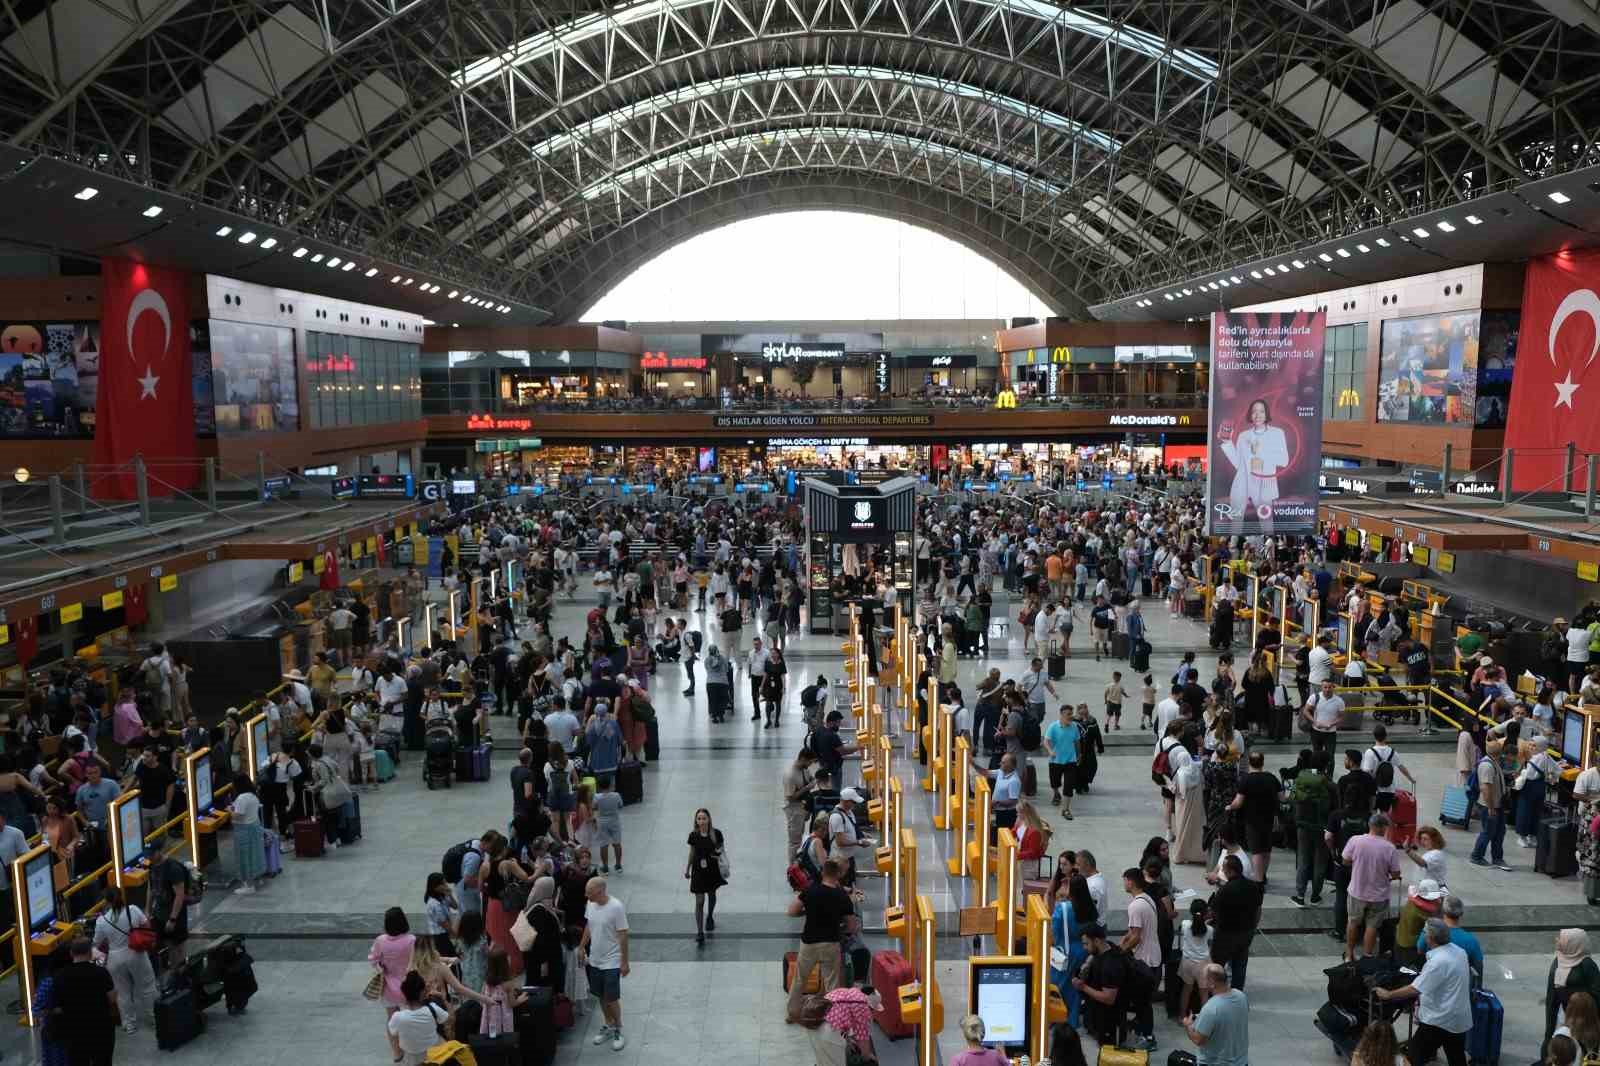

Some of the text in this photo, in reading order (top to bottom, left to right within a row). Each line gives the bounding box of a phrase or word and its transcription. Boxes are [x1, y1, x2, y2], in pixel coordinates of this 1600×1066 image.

[1219, 338, 1240, 346] dolu
[762, 342, 802, 362] SKYLAR
[1219, 349, 1248, 358] tarifeni
[1250, 350, 1269, 360] yurt
[1303, 349, 1314, 358] da
[1218, 360, 1278, 370] kullanabilirsin
[717, 416, 731, 426] DIŞ
[732, 415, 762, 425] HATLAR
[763, 413, 788, 425] GİDEN
[788, 415, 814, 425] YOLCU
[820, 415, 880, 424] INTERNATIONAL
[882, 415, 929, 424] DEPARTURES
[1109, 415, 1177, 425] McDonald's
[1273, 507, 1315, 516] vodafone
